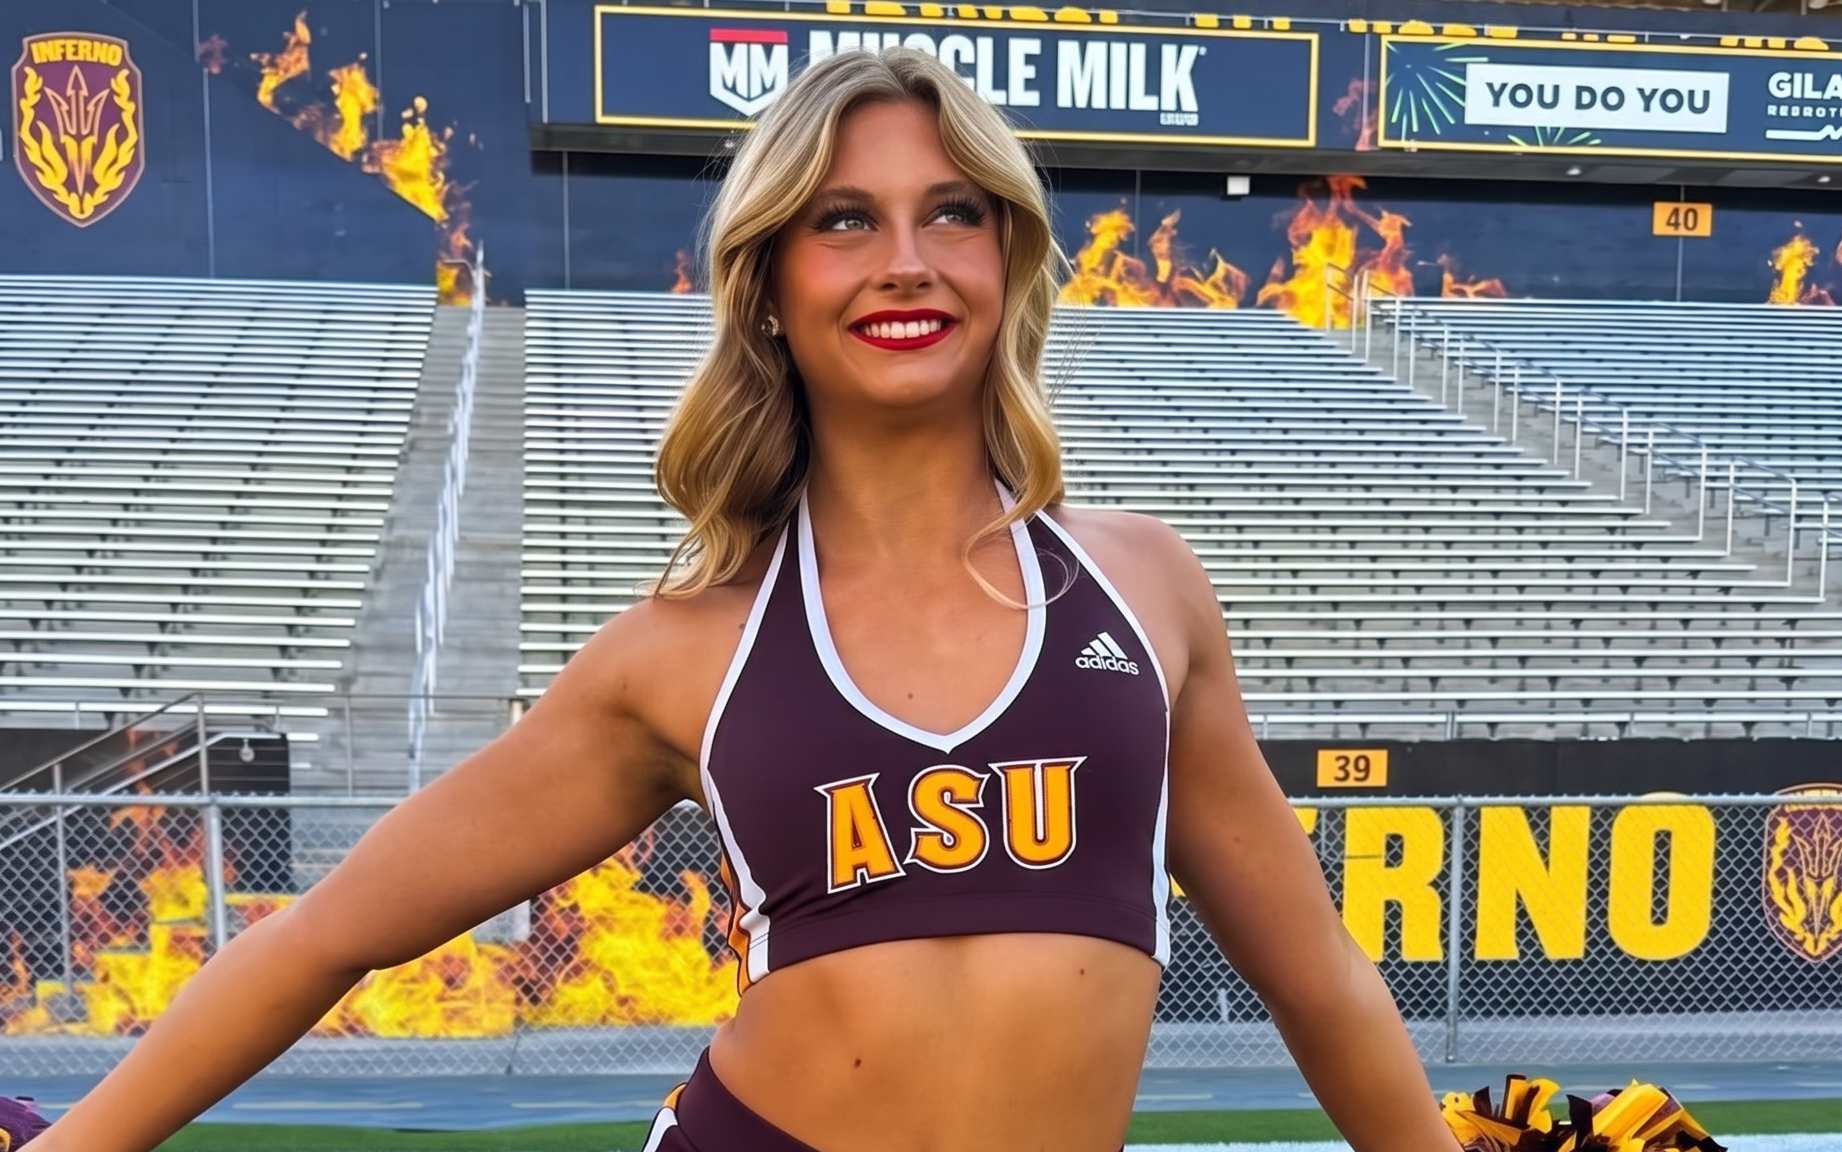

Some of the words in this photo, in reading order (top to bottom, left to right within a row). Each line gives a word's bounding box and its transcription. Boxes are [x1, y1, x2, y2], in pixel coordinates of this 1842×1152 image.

[30, 39, 122, 66] INFERNO
[1057, 40, 1198, 112] MILK
[1768, 71, 1842, 100] GILA
[1486, 82, 1560, 110] YOU
[1575, 85, 1625, 112] DO
[1637, 88, 1710, 114] YOU
[1666, 207, 1698, 231] 40
[1075, 655, 1139, 675] adidas
[1334, 754, 1371, 782] 39
[814, 756, 1088, 893] ASU
